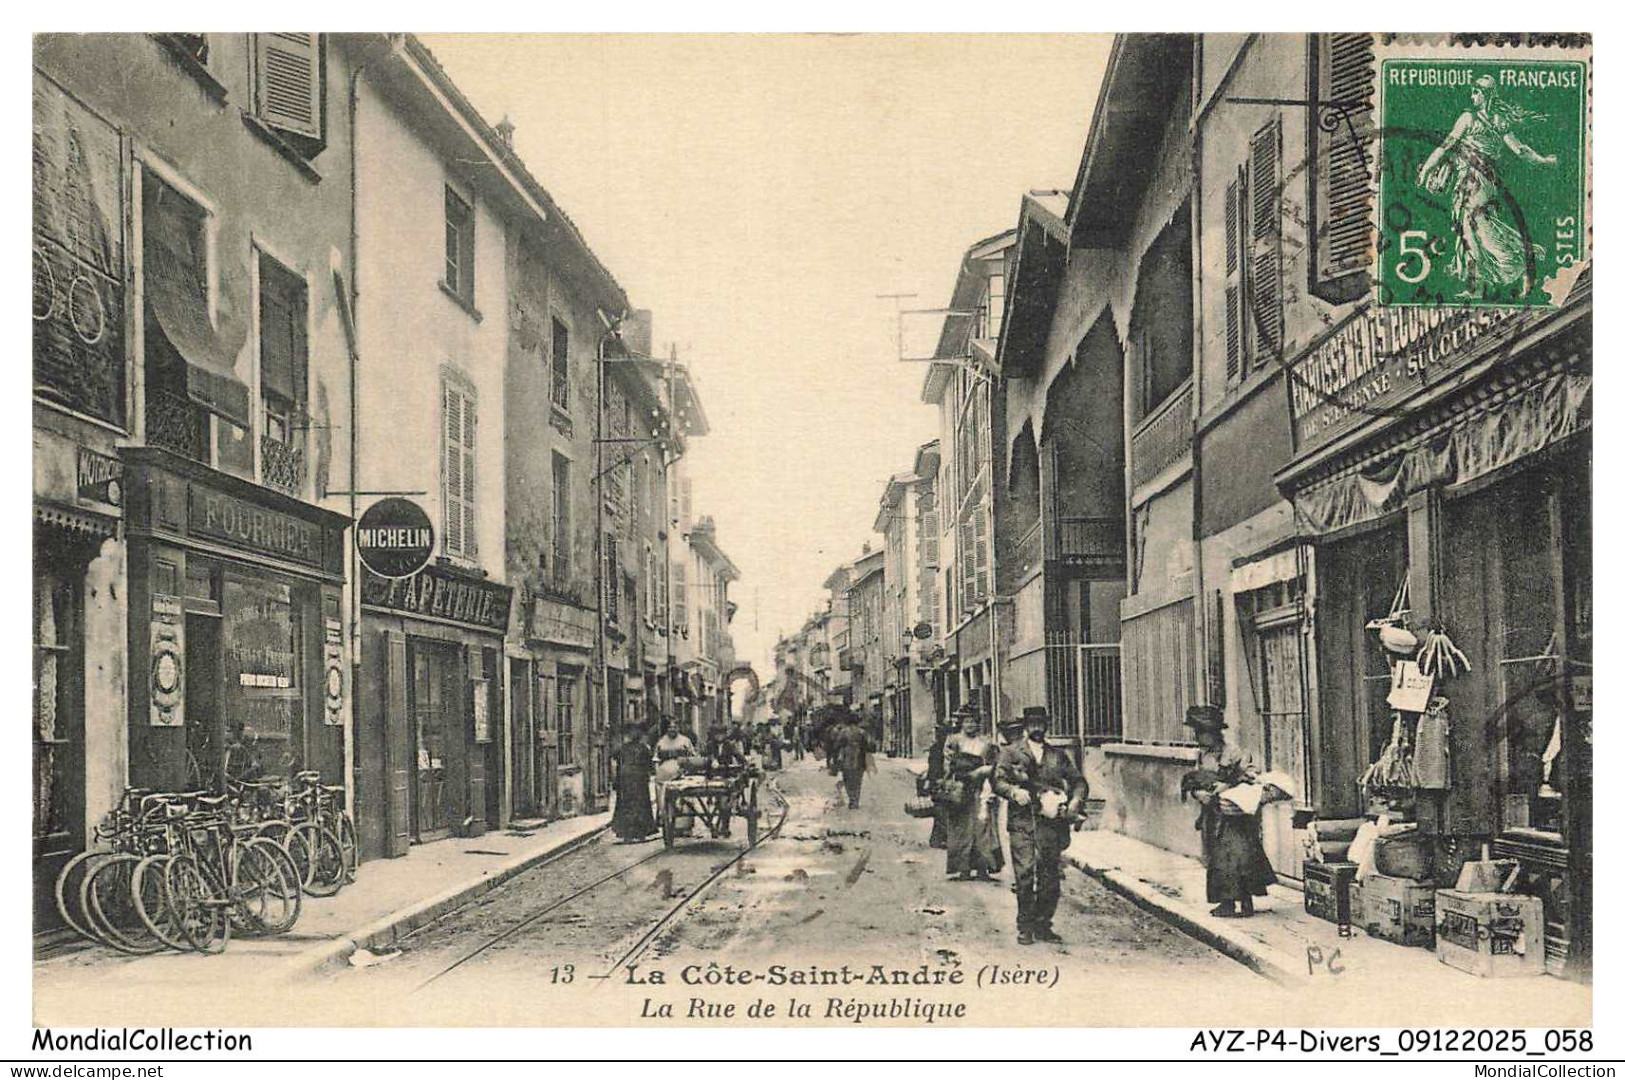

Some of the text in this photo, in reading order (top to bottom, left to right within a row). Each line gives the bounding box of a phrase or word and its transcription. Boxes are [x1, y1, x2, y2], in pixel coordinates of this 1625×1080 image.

[1500, 68, 1577, 88] FRANÇAISE
[205, 497, 312, 556] FOURNIER
[358, 528, 431, 549] MICHELIN
